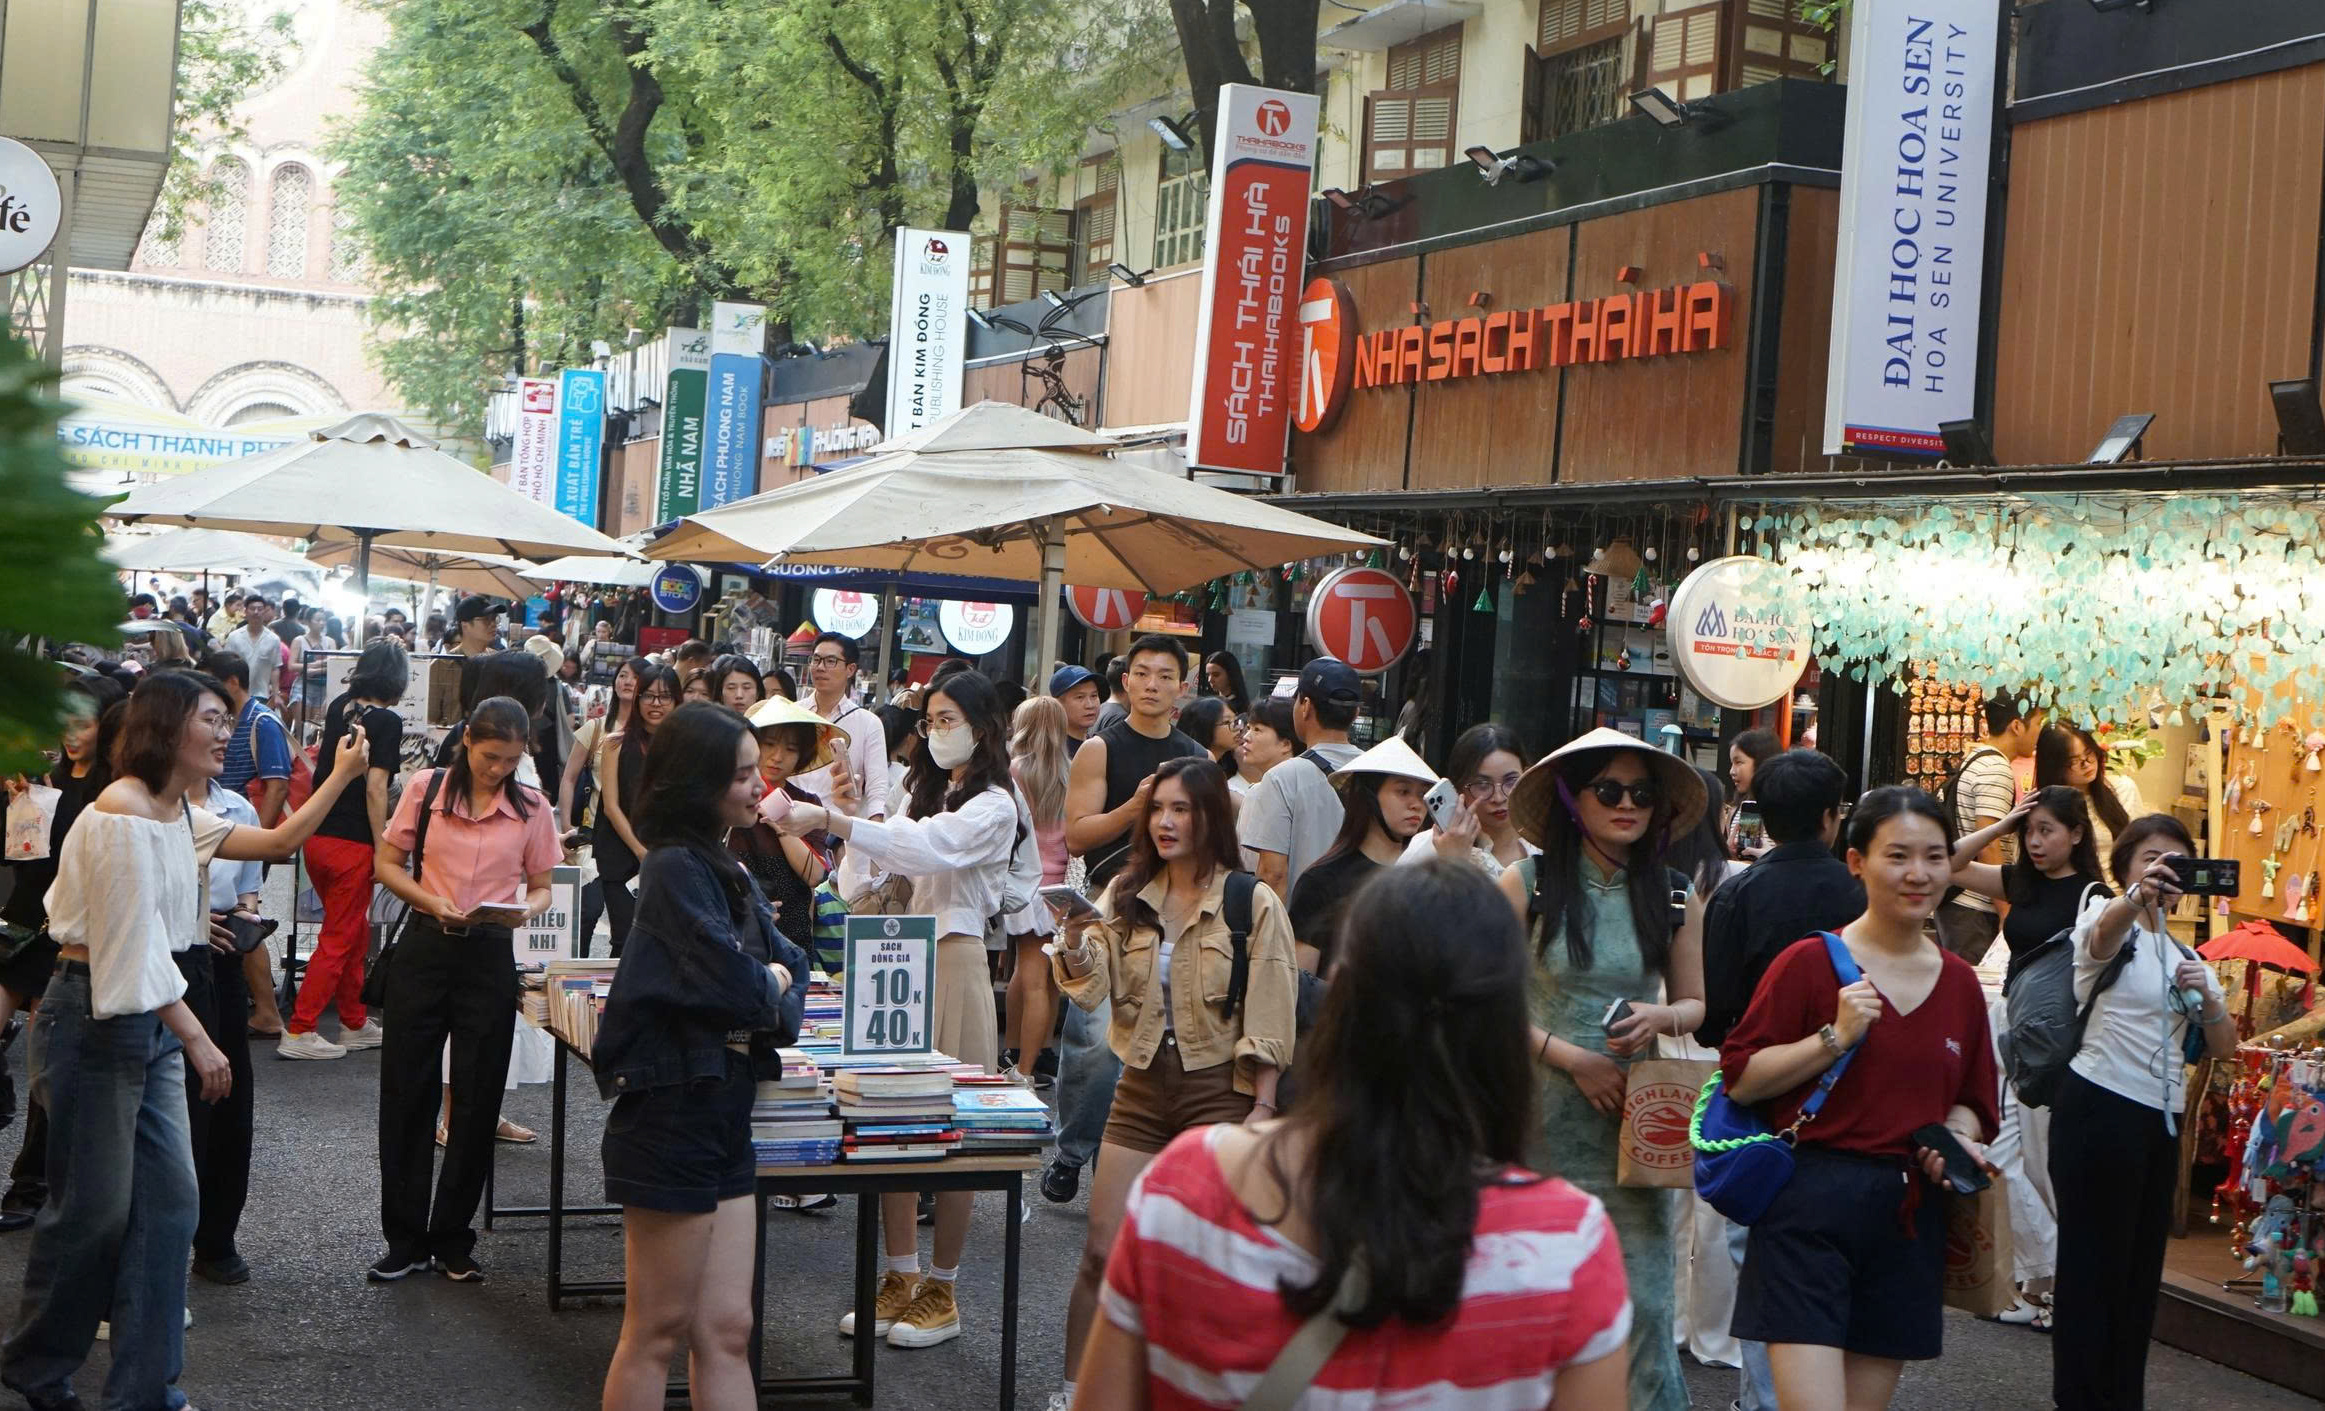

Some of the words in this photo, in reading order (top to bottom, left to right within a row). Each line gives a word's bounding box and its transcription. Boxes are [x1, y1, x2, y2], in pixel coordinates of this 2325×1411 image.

[1903, 15, 1934, 96] SEN
[1936, 23, 1967, 227] UNIVERSITY
[1896, 105, 1929, 200] HOA
[1243, 182, 1270, 236] HÀ
[1889, 208, 1923, 304] HỌC
[1930, 245, 1953, 308] SEN
[1236, 246, 1264, 330] THÁI
[914, 293, 931, 342] ĐỒNG
[934, 293, 949, 341] HOUSE
[1258, 215, 1291, 417] THAIHABOOKS
[1354, 302, 1425, 389] NHÀ
[1427, 291, 1541, 382] SÁCH
[1543, 265, 1643, 367] THÁI
[1650, 252, 1726, 356] HÀ
[914, 348, 926, 378] KIM
[1883, 313, 1917, 389] ĐẠI
[1924, 327, 1948, 393] HOA
[738, 385, 749, 418] BOOK
[908, 384, 924, 416] BẢN
[1224, 341, 1254, 444] SÁCH
[73, 425, 140, 450] SÁCH
[144, 431, 233, 457] THÀNH
[537, 419, 547, 444] MINH
[681, 416, 699, 455] NAM
[711, 471, 728, 509] SÁCH
[721, 372, 736, 406] NAM
[736, 422, 746, 449] NAM
[1855, 432, 1897, 443] RESPECT
[1900, 436, 1944, 447] DIVERSIT
[676, 461, 696, 498] NHÃ
[662, 501, 669, 510] TY
[529, 934, 556, 950] NHI
[871, 968, 910, 1006] 10
[913, 990, 922, 1004] K
[866, 1009, 909, 1046] 40
[912, 1031, 921, 1045] K
[1632, 1146, 1692, 1164] COFFE
